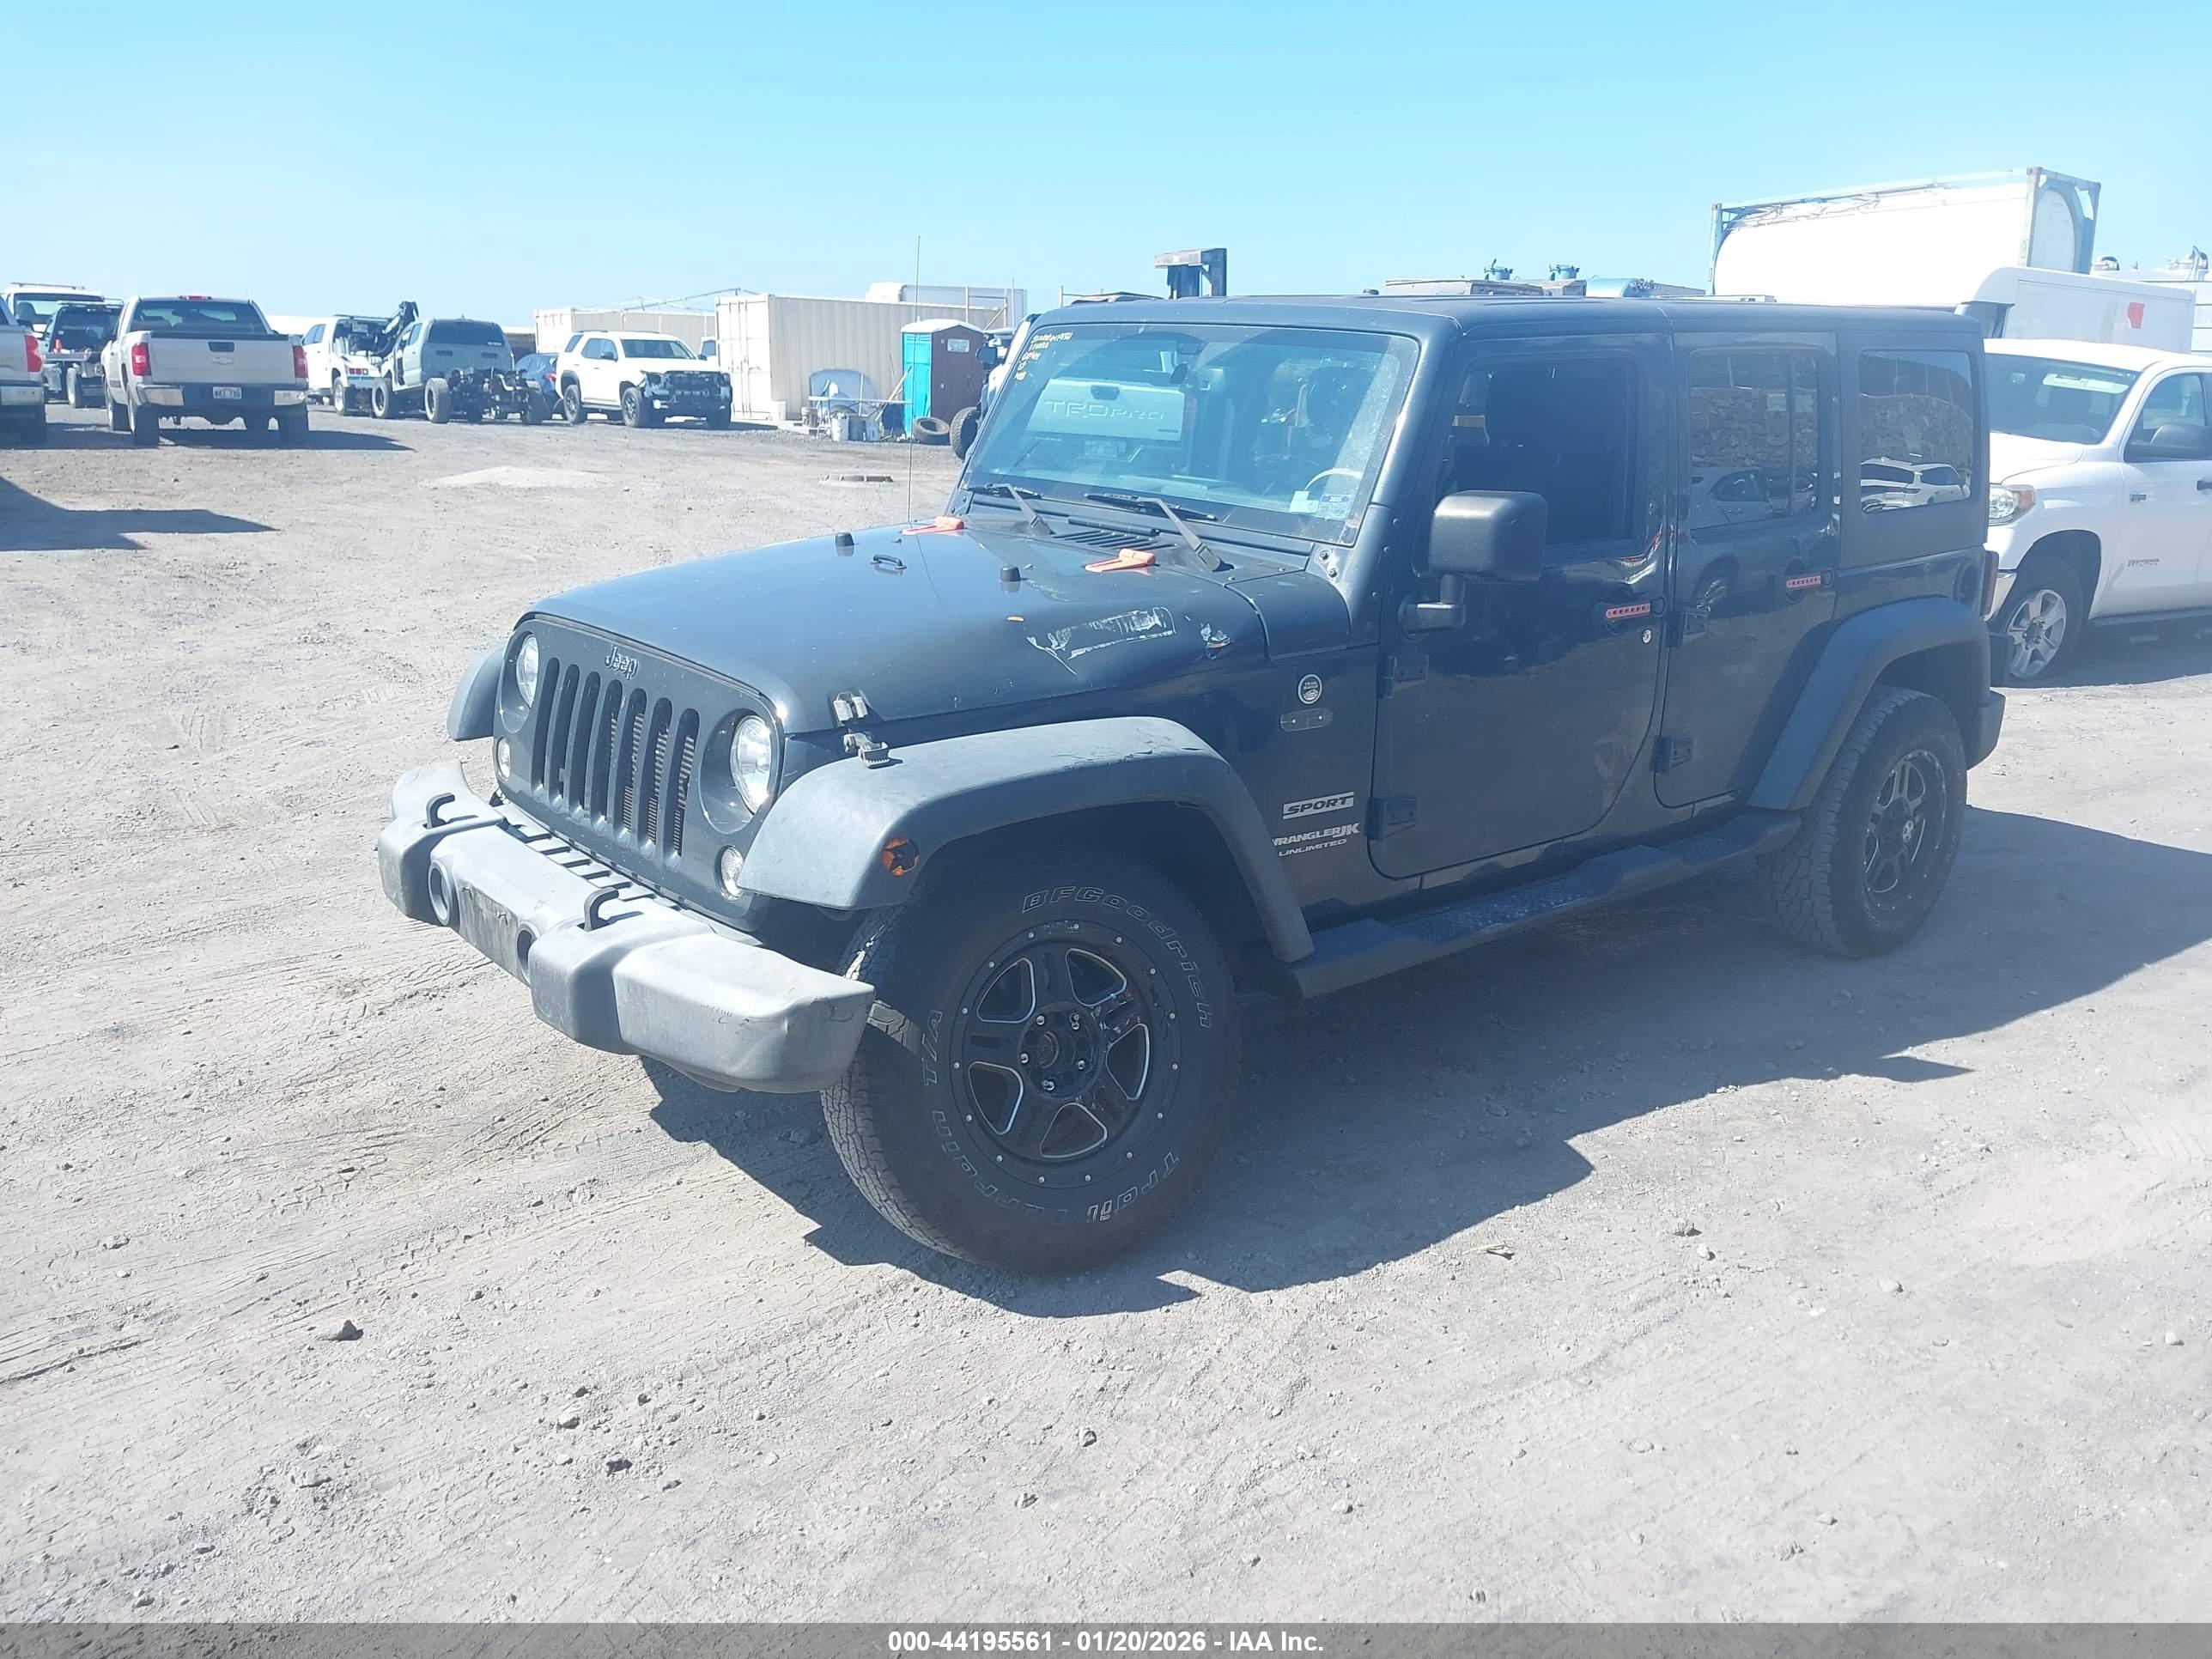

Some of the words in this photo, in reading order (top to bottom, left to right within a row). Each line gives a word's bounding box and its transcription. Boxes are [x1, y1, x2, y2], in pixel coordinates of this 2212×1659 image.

[1044, 399, 1109, 419] TRD
[605, 647, 639, 680] Jeep
[1284, 798, 1348, 816] SPORT
[1278, 838, 1347, 857] UNLIMITED
[1023, 885, 1212, 1029] BFGoodrich
[921, 1009, 943, 1087] T/A
[1086, 1152, 1180, 1224] Trail
